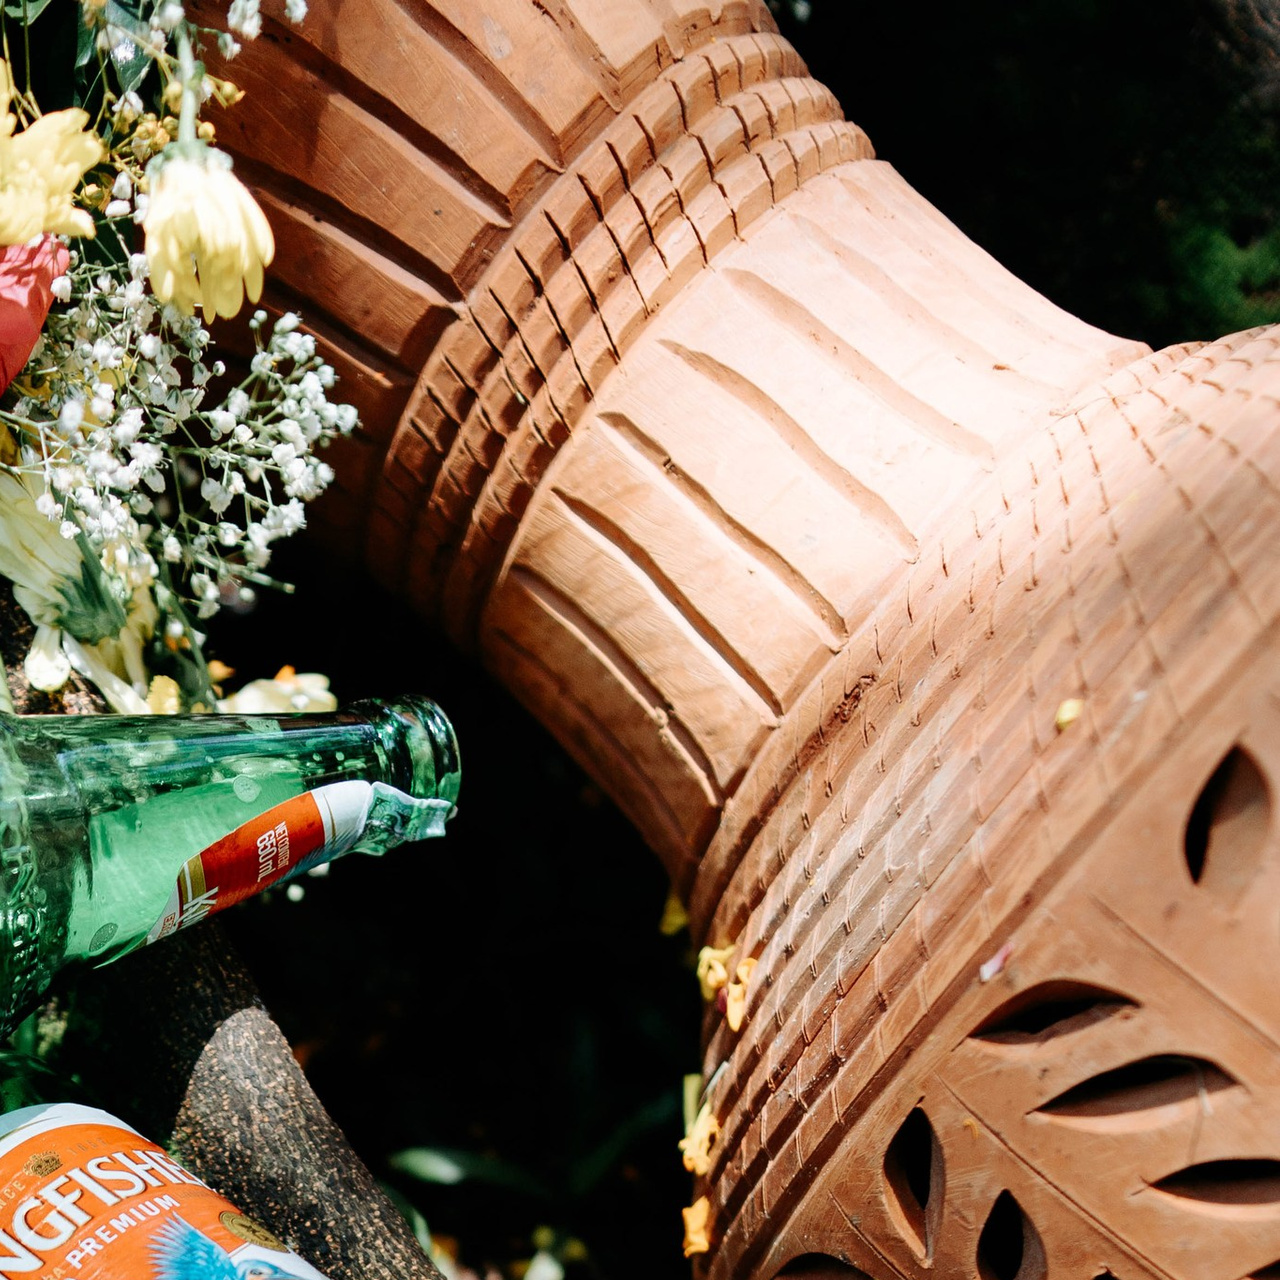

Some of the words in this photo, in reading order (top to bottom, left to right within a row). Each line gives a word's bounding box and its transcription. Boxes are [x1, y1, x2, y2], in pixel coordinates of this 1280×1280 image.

[256, 829, 277, 864] 650
[274, 821, 289, 839] NET
[65, 1194, 181, 1270] PREMIUM
